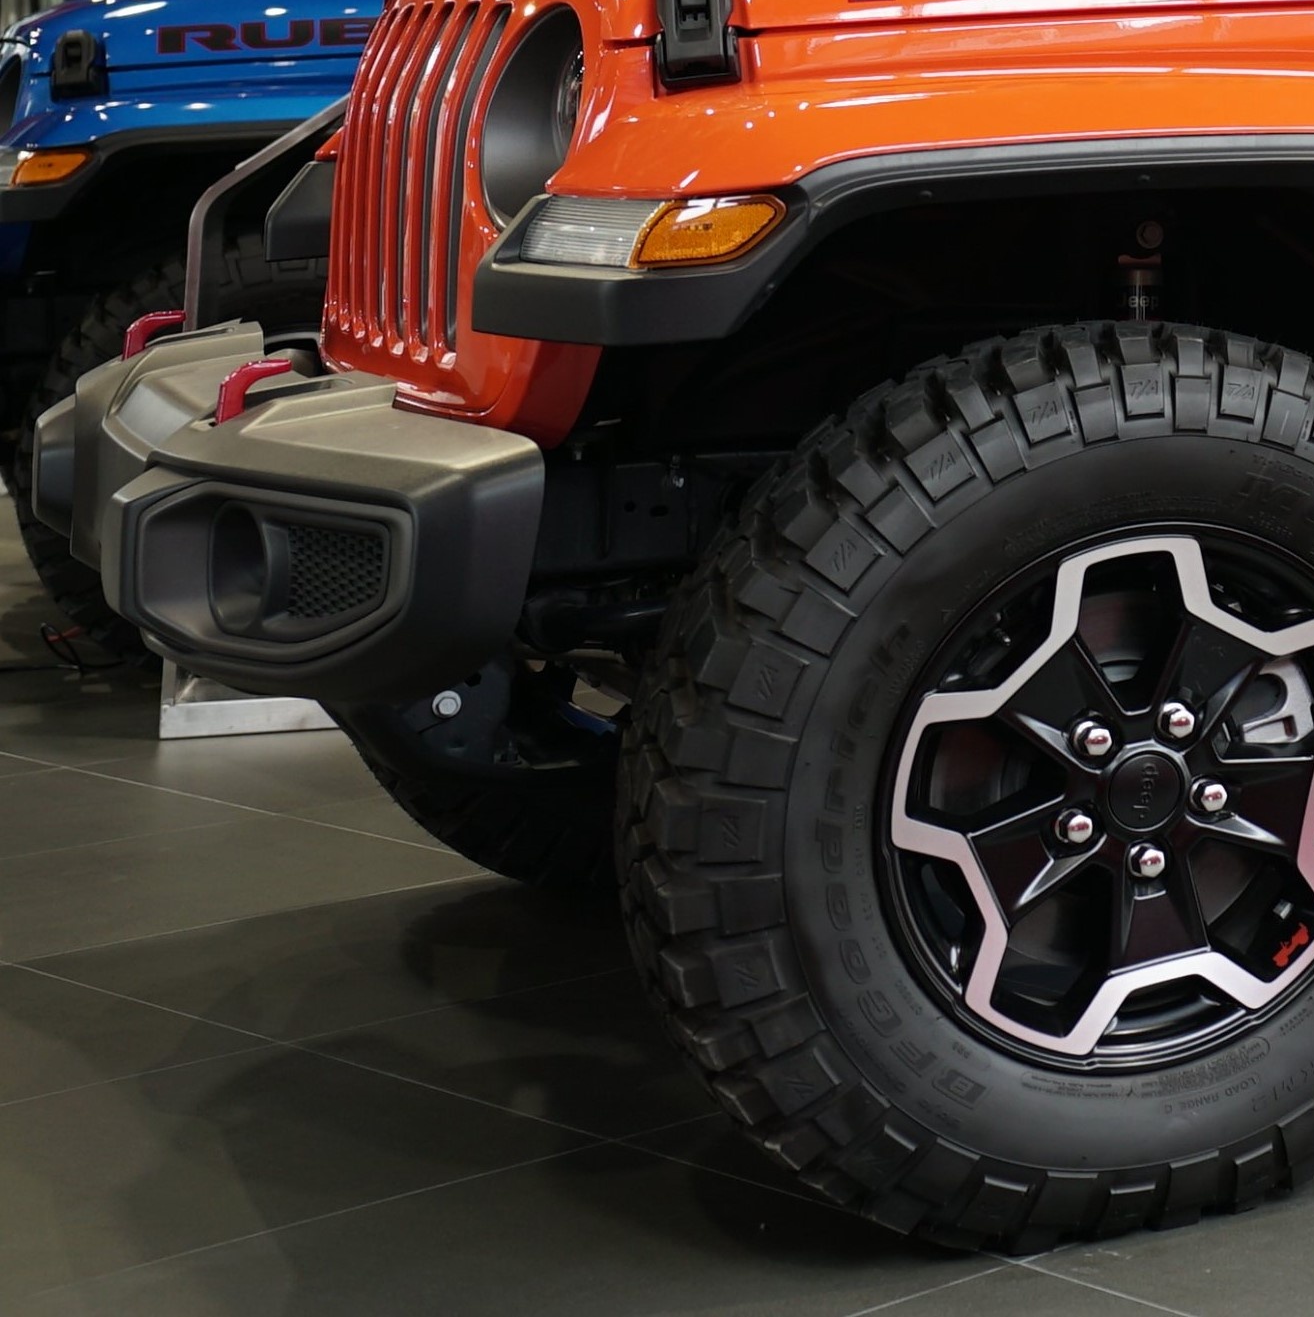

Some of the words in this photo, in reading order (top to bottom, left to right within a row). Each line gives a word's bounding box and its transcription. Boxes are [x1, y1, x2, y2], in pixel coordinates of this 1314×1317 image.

[1128, 379, 1159, 399] T/A
[1225, 381, 1257, 401] T/A
[1026, 400, 1060, 426] T/A
[927, 452, 955, 482] T/A
[831, 541, 860, 574] T/A
[1131, 761, 1160, 820] Jeep
[815, 619, 988, 1113] BFGoodrich
[1222, 1075, 1257, 1098] LOAD
[1178, 1091, 1220, 1110] RANGE
